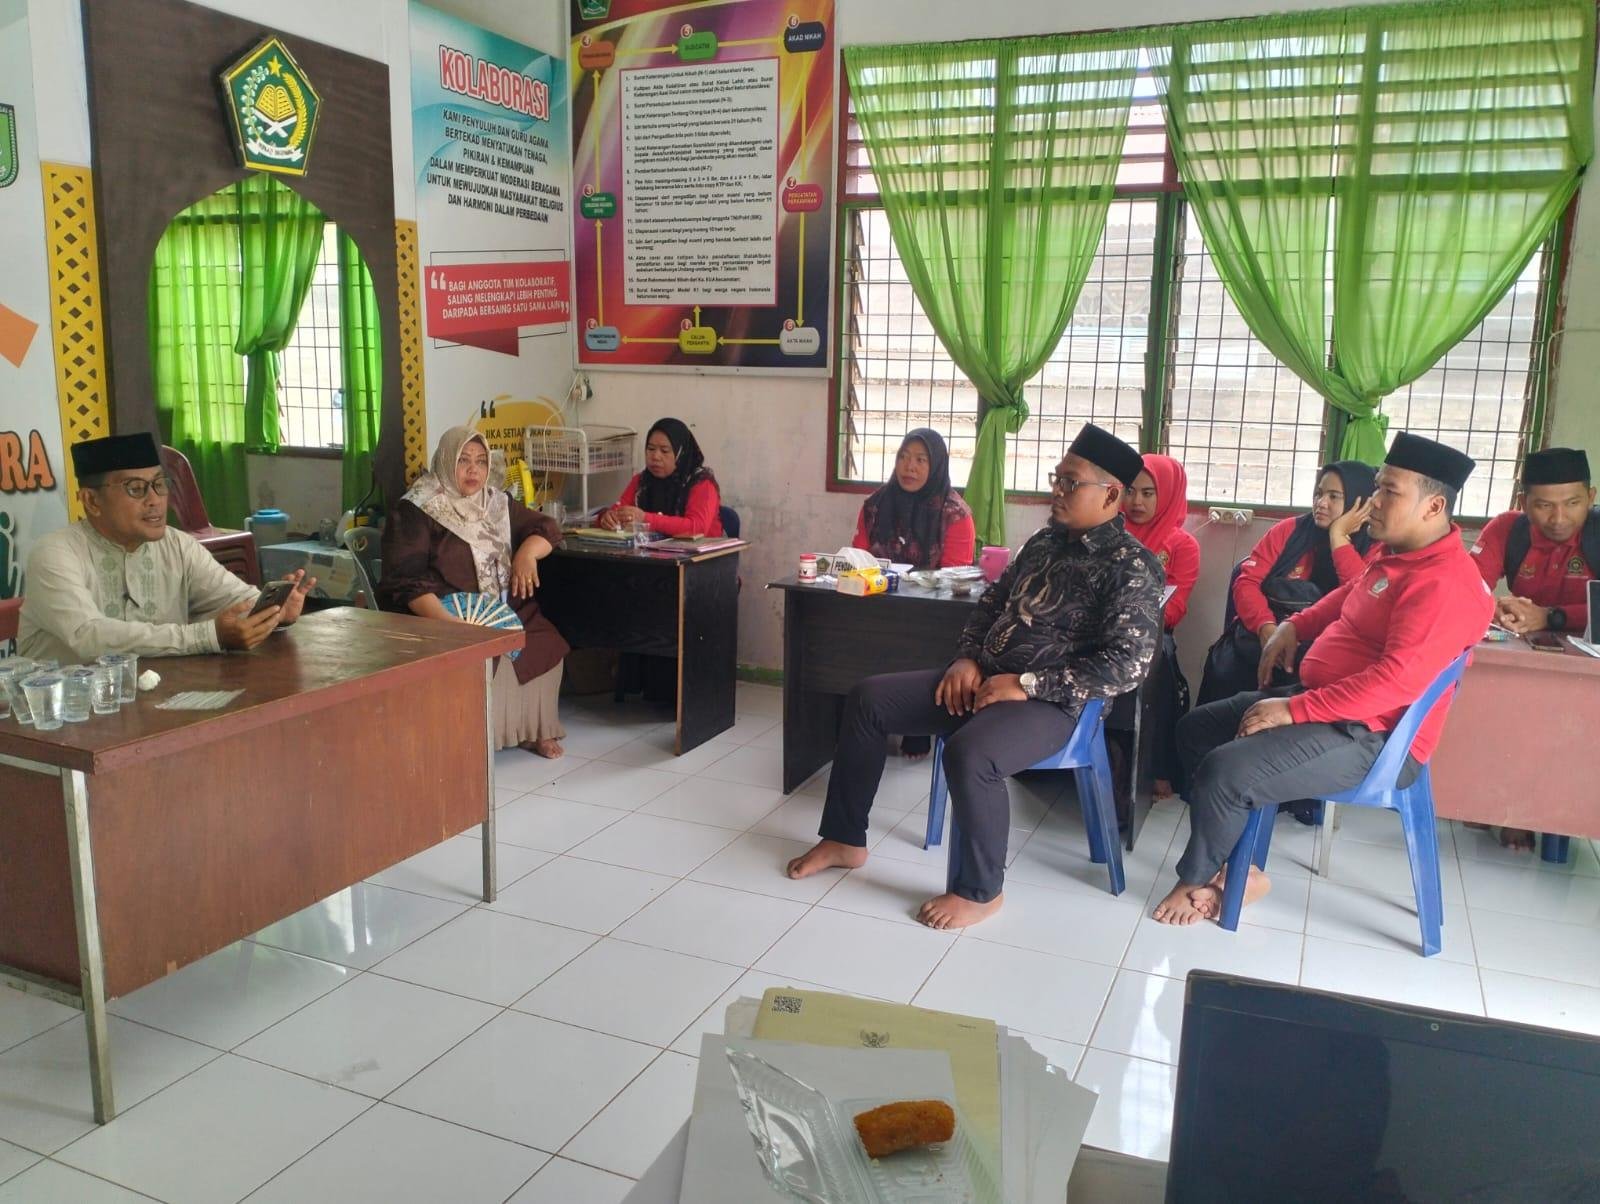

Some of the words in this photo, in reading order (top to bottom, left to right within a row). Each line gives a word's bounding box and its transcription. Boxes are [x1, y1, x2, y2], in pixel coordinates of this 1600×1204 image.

[439, 45, 549, 121] KOLABORASI
[443, 109, 461, 121] KAMI
[462, 113, 496, 131] PENYULUH
[497, 125, 510, 137] DAN
[511, 128, 528, 143] GURU
[529, 134, 549, 148] AGAMA
[445, 127, 480, 145] BERTEKAD
[481, 135, 523, 155] MENYATUKAN
[463, 148, 489, 164] PIKIRAN
[491, 157, 496, 165] &
[497, 158, 534, 175] KEMAMPUAN
[430, 157, 454, 171] DALAM
[455, 162, 498, 181] MEMPERKUAT
[500, 174, 530, 189] MODERASI
[531, 182, 560, 197] BERAGAMA
[427, 174, 451, 187] UNTUK
[453, 179, 498, 198] MEWUJUDKAN
[500, 189, 538, 207] MASYARAKAT
[539, 197, 563, 212] RELIGIUS
[448, 194, 462, 206] DAN
[463, 197, 493, 213] HARMONI
[494, 204, 515, 217] DALAM
[516, 208, 548, 223] PERBEDAAN
[447, 294, 473, 305] SALING
[475, 291, 516, 303] MELENGKAPI
[516, 290, 533, 300] LEBIH
[533, 288, 557, 299] PENTING
[449, 281, 466, 291] BAGI
[468, 279, 501, 290] ANGGOTA
[503, 278, 514, 289] TIM
[442, 307, 478, 319] DARIPADA
[479, 305, 512, 316] BERSAING
[513, 303, 528, 313] SATU
[529, 302, 546, 312] SAMA
[486, 429, 501, 439] JIKA
